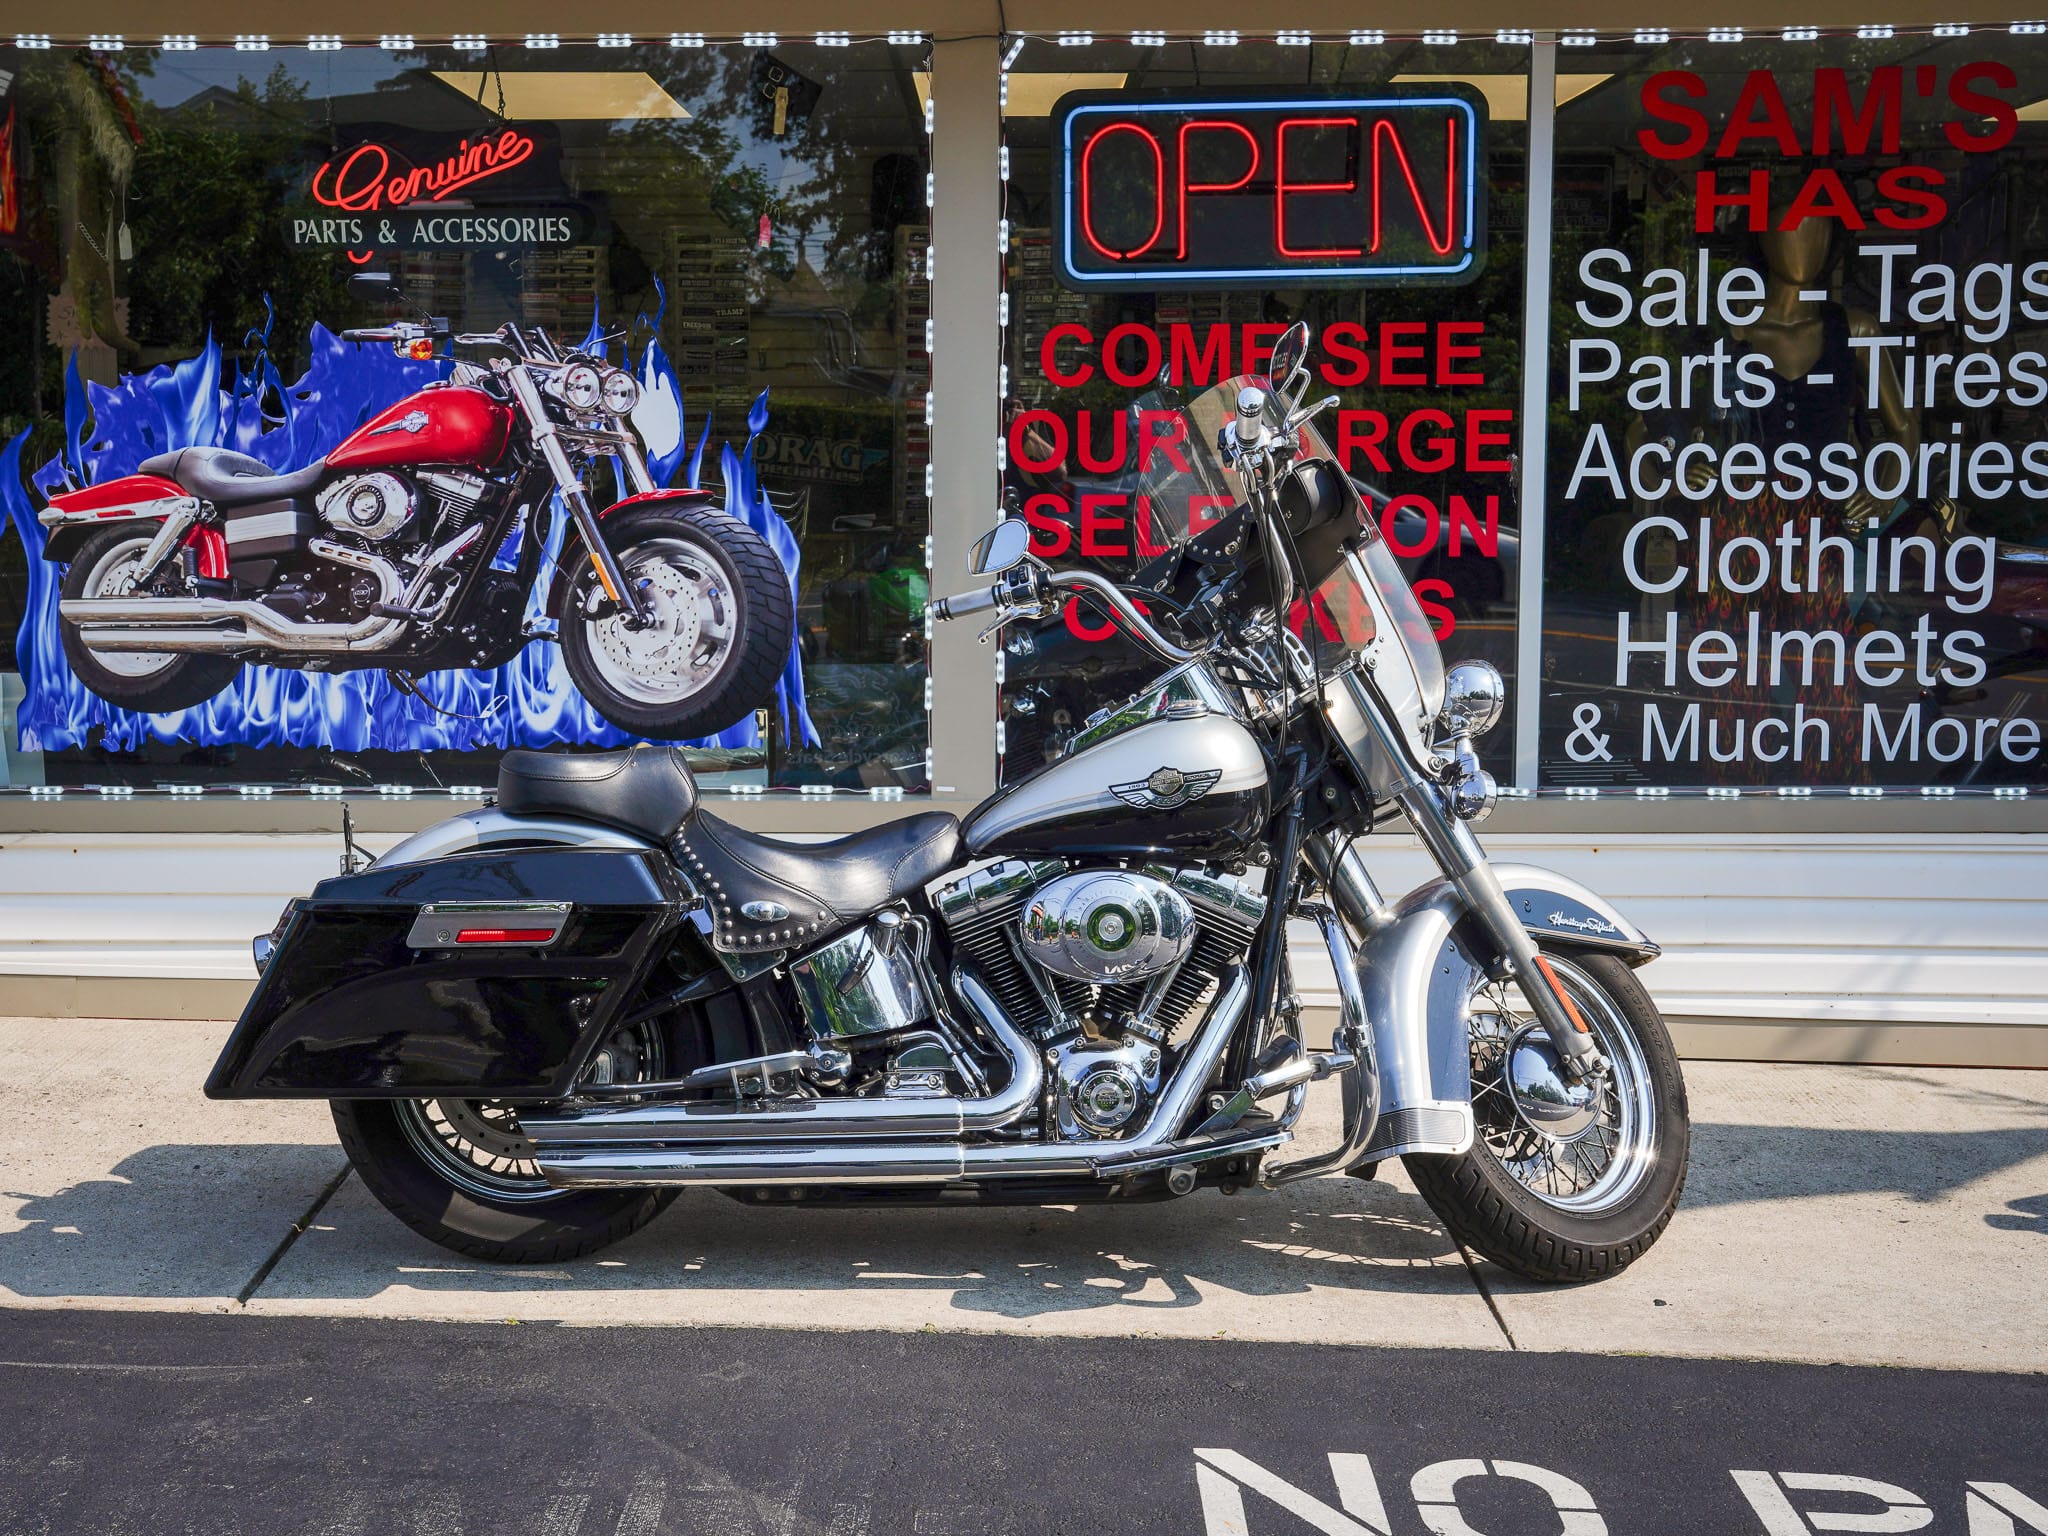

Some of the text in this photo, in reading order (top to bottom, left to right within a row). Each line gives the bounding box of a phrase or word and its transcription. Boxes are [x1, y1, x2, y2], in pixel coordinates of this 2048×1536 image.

[1637, 63, 2019, 161] SAM'S
[311, 130, 534, 212] Genuine
[1081, 117, 1456, 260] OPEN
[1694, 168, 1948, 233] HAS
[293, 217, 571, 244] PARTS & ACCESSORIES
[1575, 247, 1766, 328] Sale
[1858, 244, 2048, 343] Tags
[1040, 321, 1484, 388] COME SEE
[1569, 337, 1776, 411] Parts
[1847, 329, 2048, 409] Tires
[757, 462, 863, 484] pecialties
[1008, 409, 1513, 474] OUR RGE
[1564, 422, 2048, 501] Accessories
[1622, 516, 1996, 614] Clothing
[1616, 611, 1986, 687] Helmets
[1564, 702, 2040, 763] & Much More
[1623, 984, 1666, 1053] DUNLOP
[1192, 1447, 1609, 1536] NO
